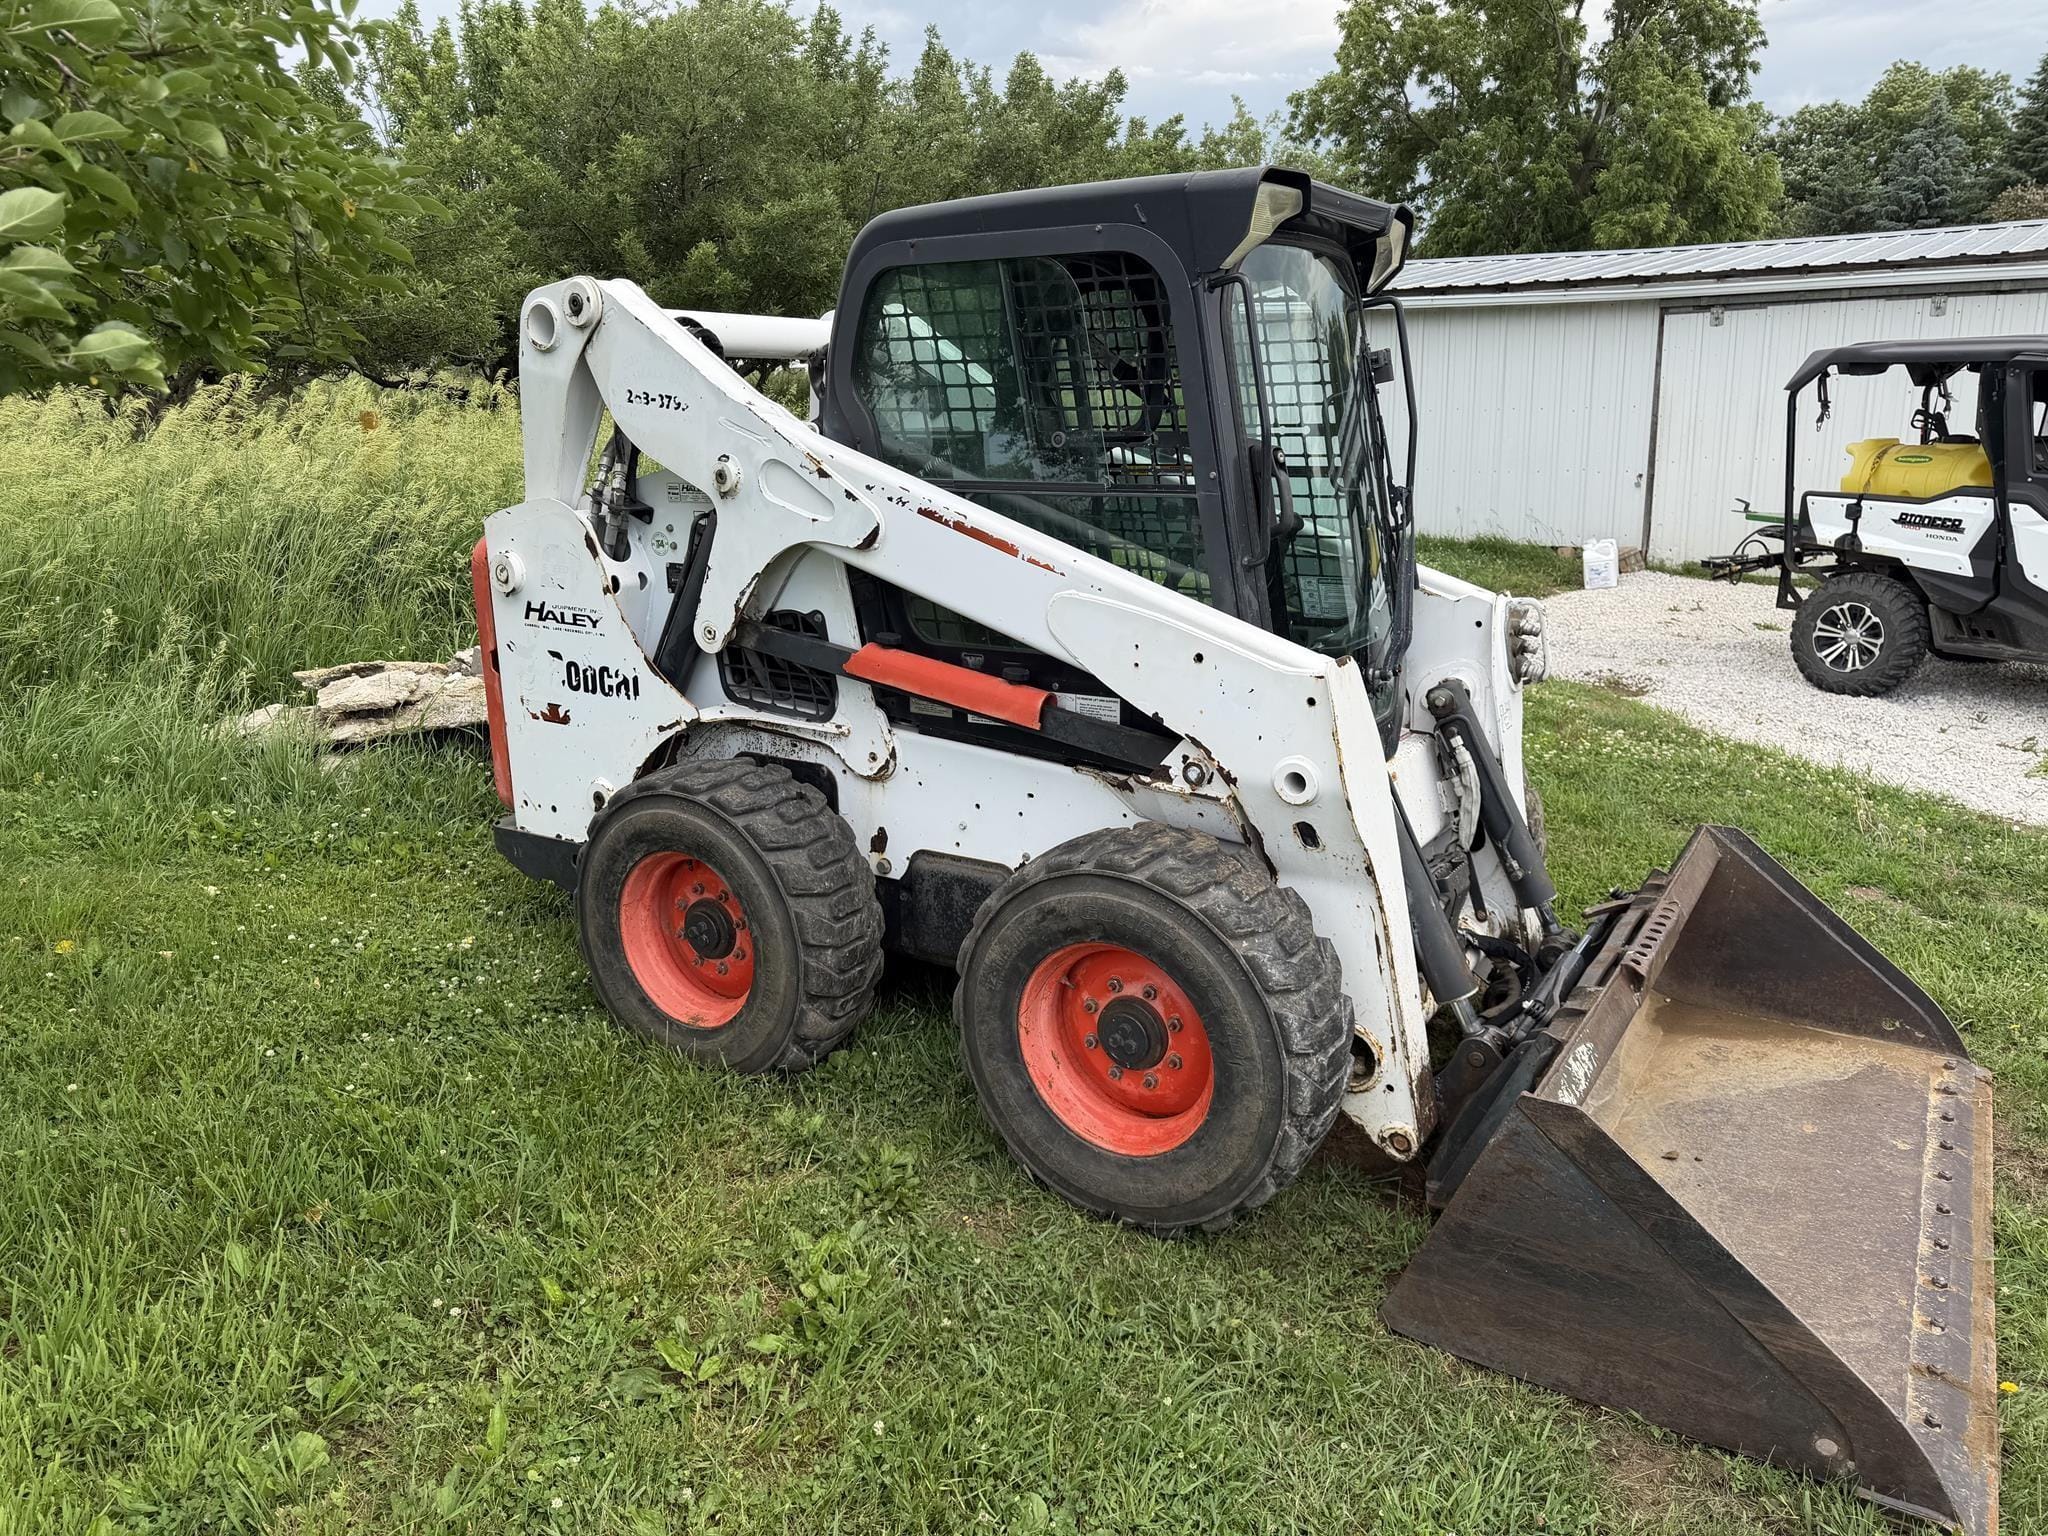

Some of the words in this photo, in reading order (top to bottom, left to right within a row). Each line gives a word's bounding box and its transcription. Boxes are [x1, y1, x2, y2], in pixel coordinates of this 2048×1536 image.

[1898, 512, 1964, 530] PIONEER
[1925, 533, 1959, 542] HONDA
[524, 600, 603, 629] HALEY
[551, 604, 587, 613] QUIPMENT
